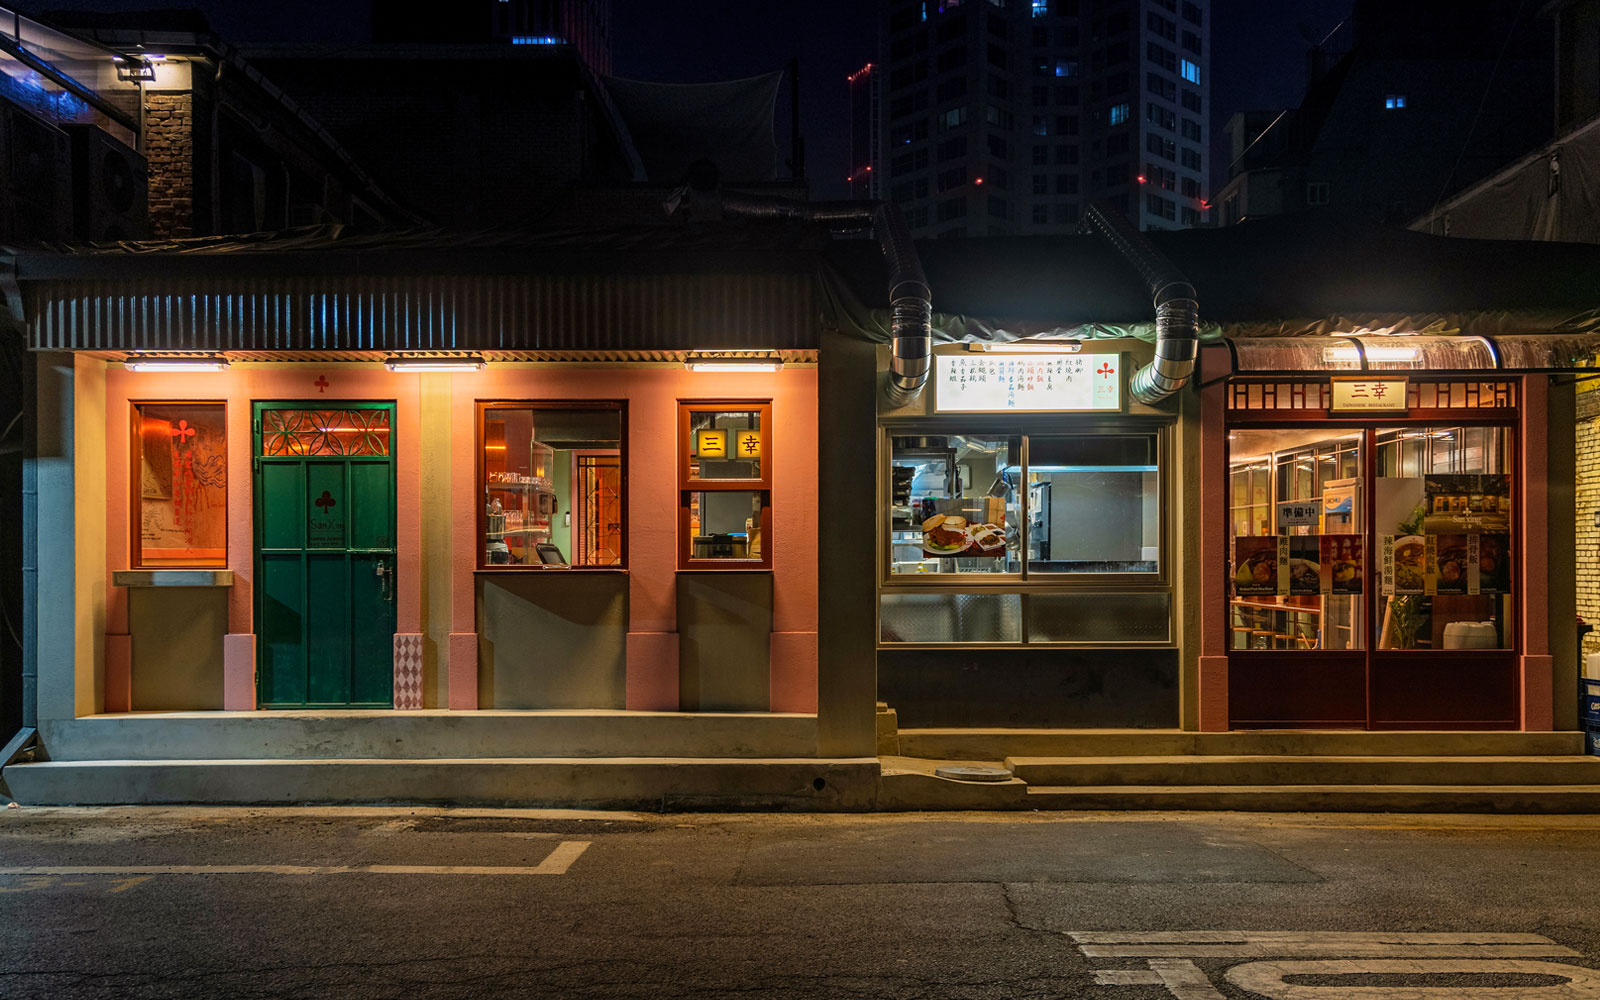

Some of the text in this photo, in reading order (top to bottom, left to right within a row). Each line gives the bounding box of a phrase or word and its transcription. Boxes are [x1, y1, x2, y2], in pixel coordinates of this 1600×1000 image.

[1351, 381, 1389, 400] 三幸
[1282, 506, 1315, 519] 準備中
[1383, 535, 1393, 585] 辣海鮮湯麵
[1425, 535, 1436, 574] 紅燒肉飯
[1469, 535, 1479, 564] 排骨飯
